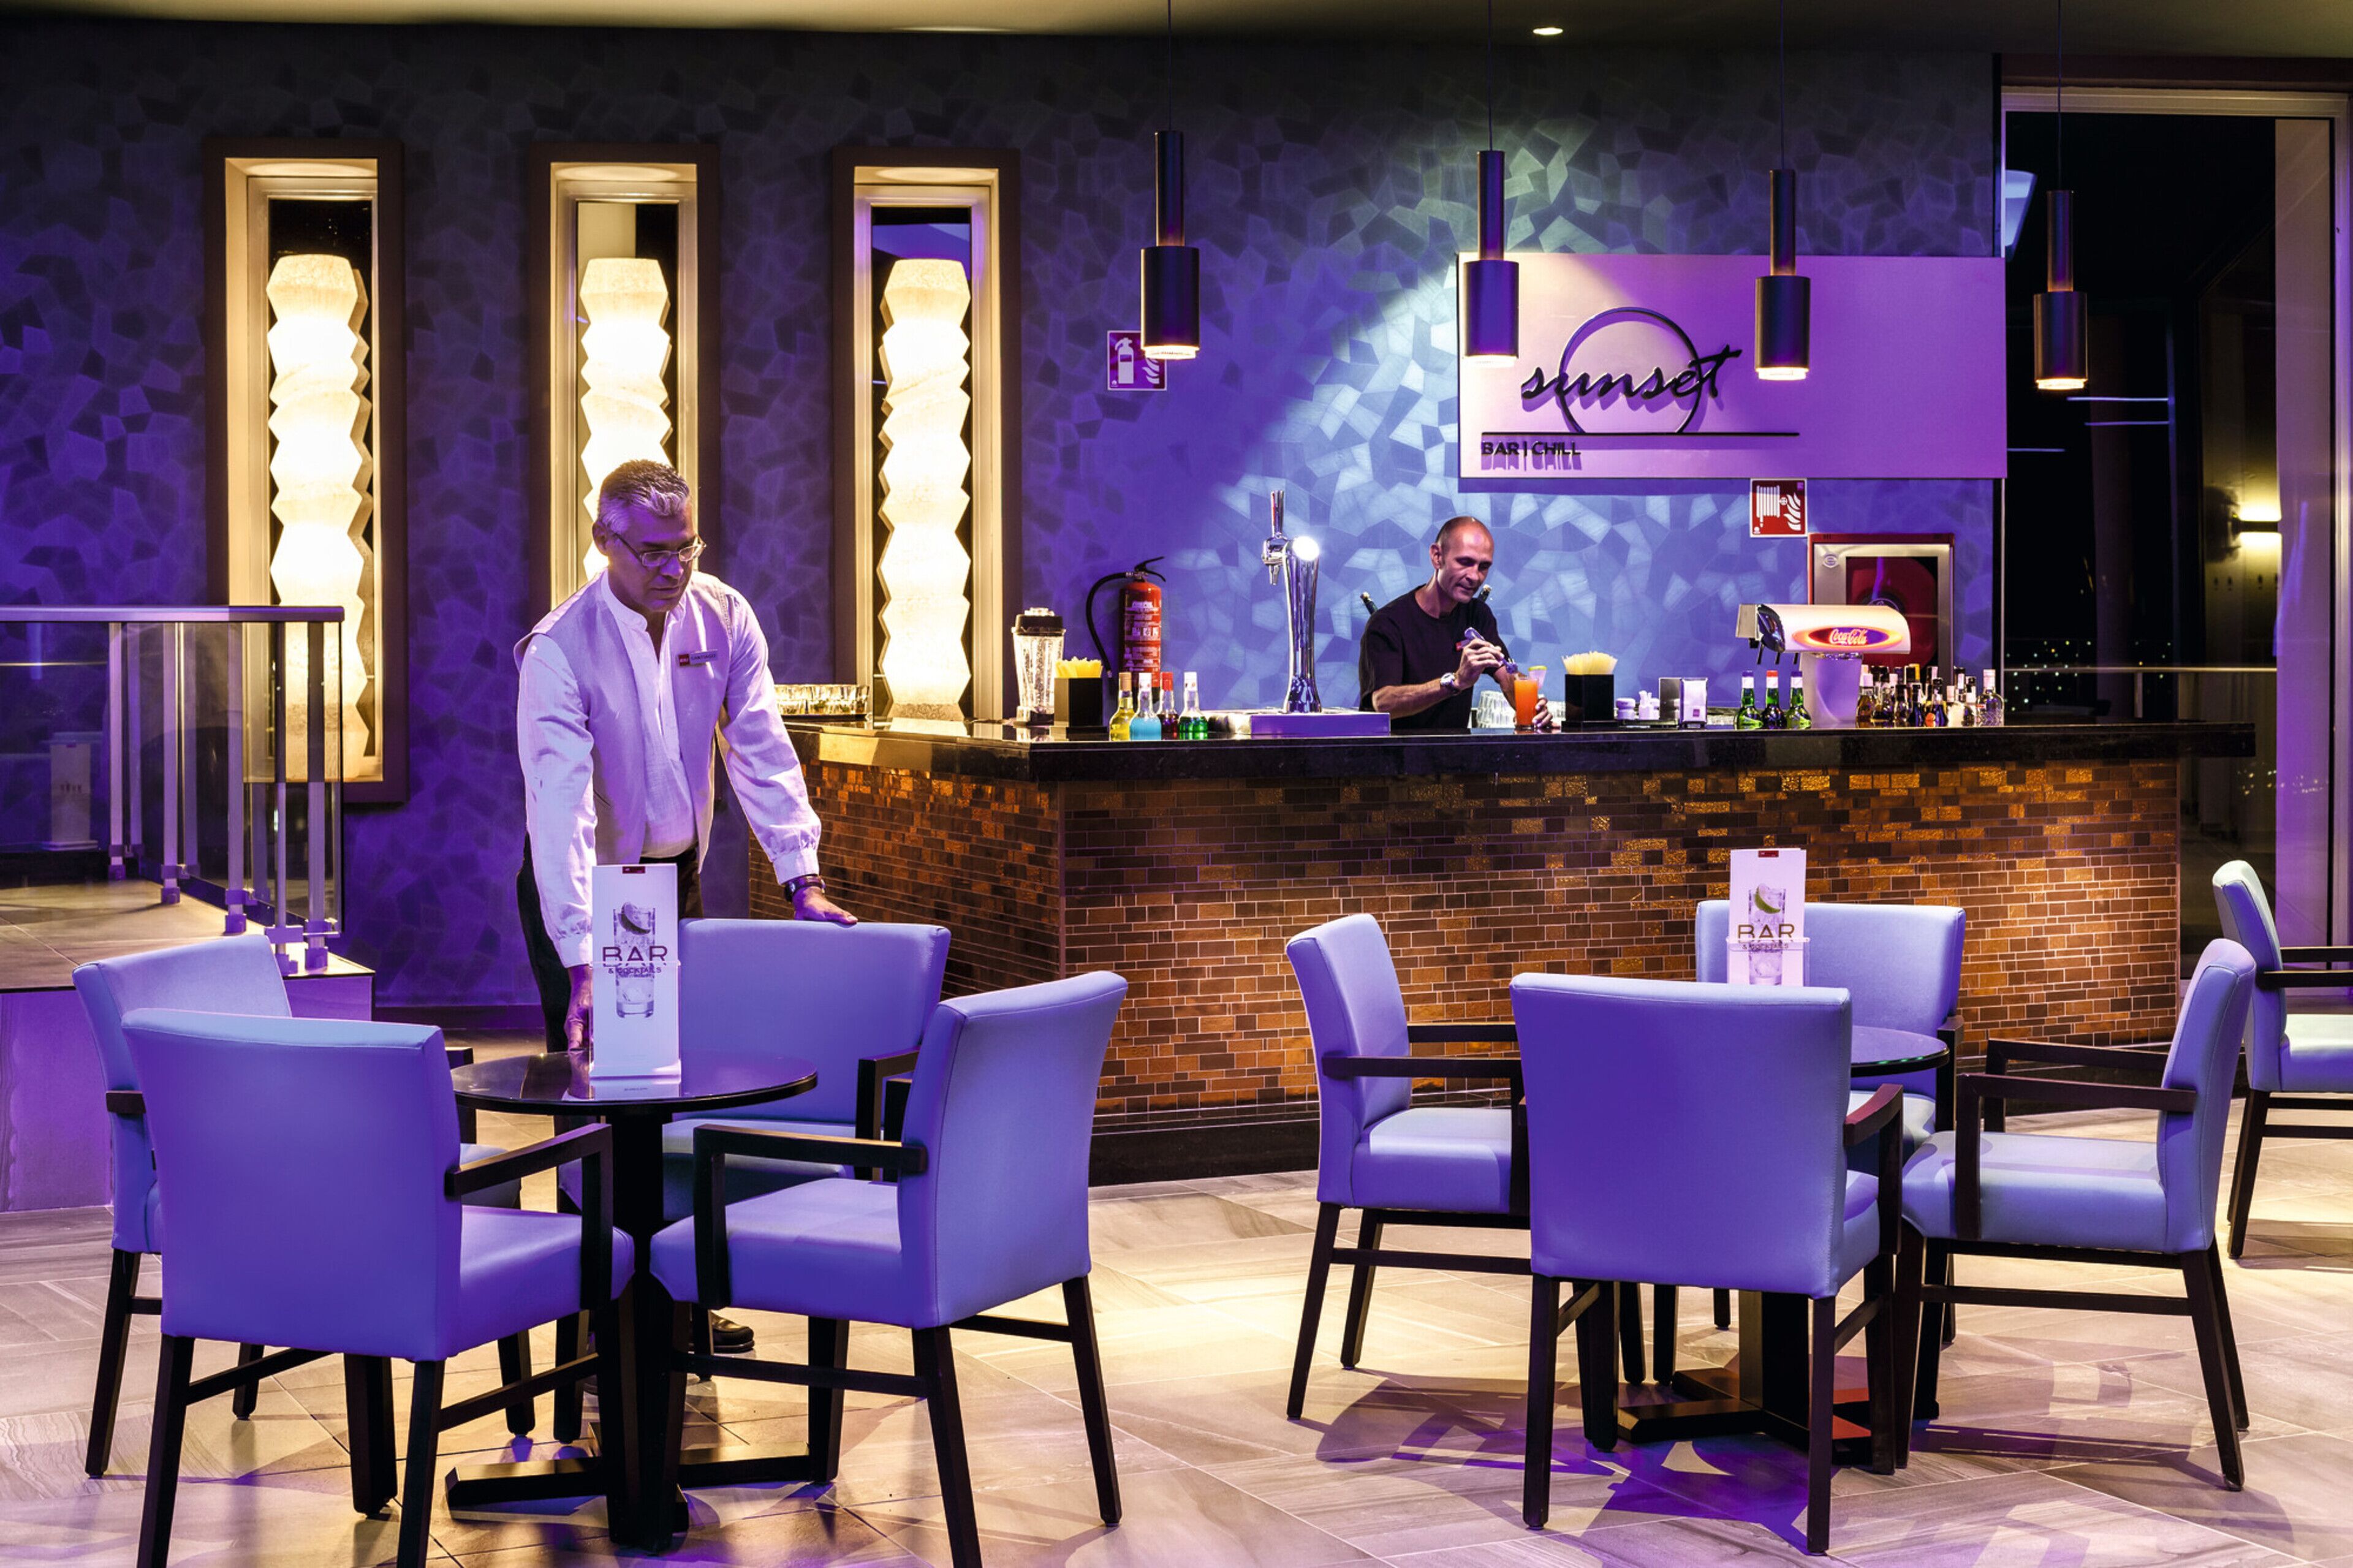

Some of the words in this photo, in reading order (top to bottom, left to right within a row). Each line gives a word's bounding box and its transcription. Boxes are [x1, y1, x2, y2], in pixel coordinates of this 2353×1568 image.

[1520, 344, 1743, 399] sunset
[1482, 441, 1519, 455] BAR
[1531, 441, 1582, 455] CHILL
[1829, 629, 1868, 645] Coca-Cola
[1738, 924, 1795, 943] BAR
[602, 945, 667, 967] BAR
